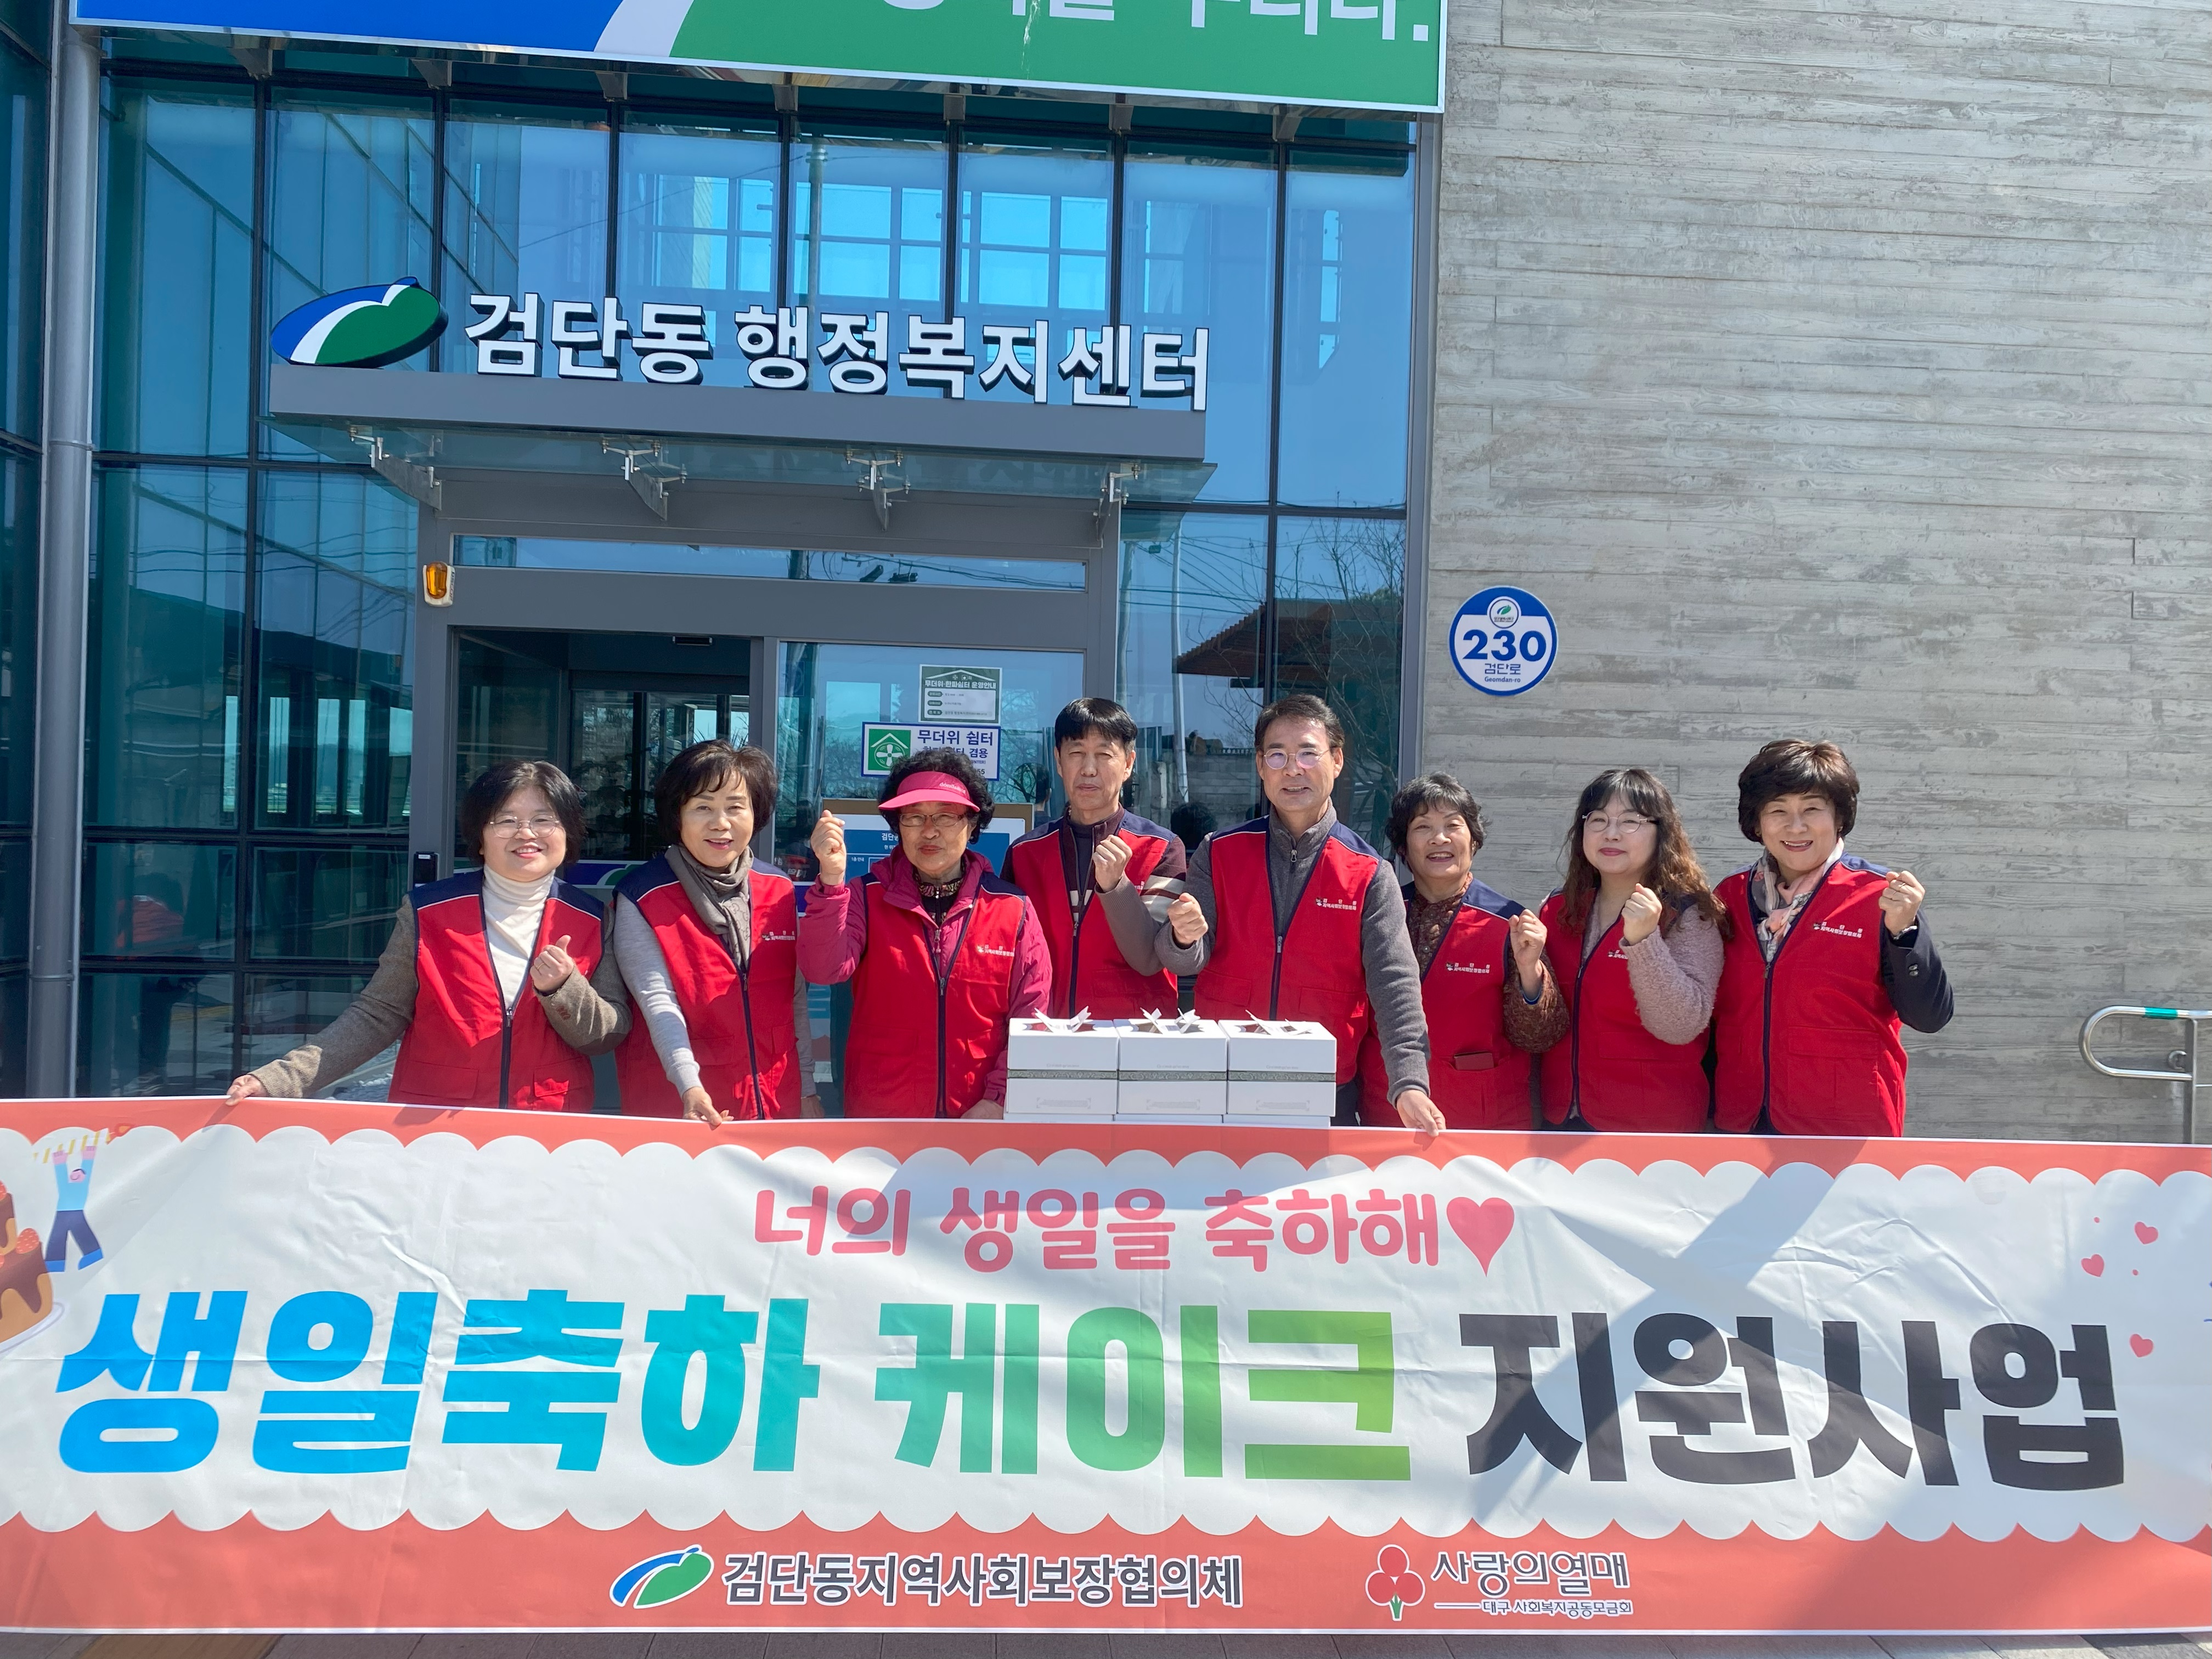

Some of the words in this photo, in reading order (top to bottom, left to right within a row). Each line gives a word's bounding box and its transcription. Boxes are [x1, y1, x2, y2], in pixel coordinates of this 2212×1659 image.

[466, 292, 714, 385] 검단동
[735, 305, 1209, 411] 행정복지센터
[1463, 629, 1547, 662] 230
[1485, 663, 1521, 675] 검단로
[917, 730, 960, 744] 무더위
[966, 731, 993, 746] 쉼터
[969, 748, 988, 758] 겸용
[755, 1185, 911, 1256] 너의
[940, 1187, 1176, 1272] 생일을
[1205, 1188, 1438, 1272] 축하해
[56, 1290, 820, 1474] 생일축하
[875, 1303, 1411, 1481] 케이크
[1459, 1312, 2124, 1491] 지원사업
[723, 1552, 1243, 1607] 검단동지역사회보장협의체
[1431, 1551, 1630, 1597] 사랑의열매
[1483, 1601, 1510, 1613] 대구
[1514, 1600, 1632, 1618] 사회복지공동모금회
